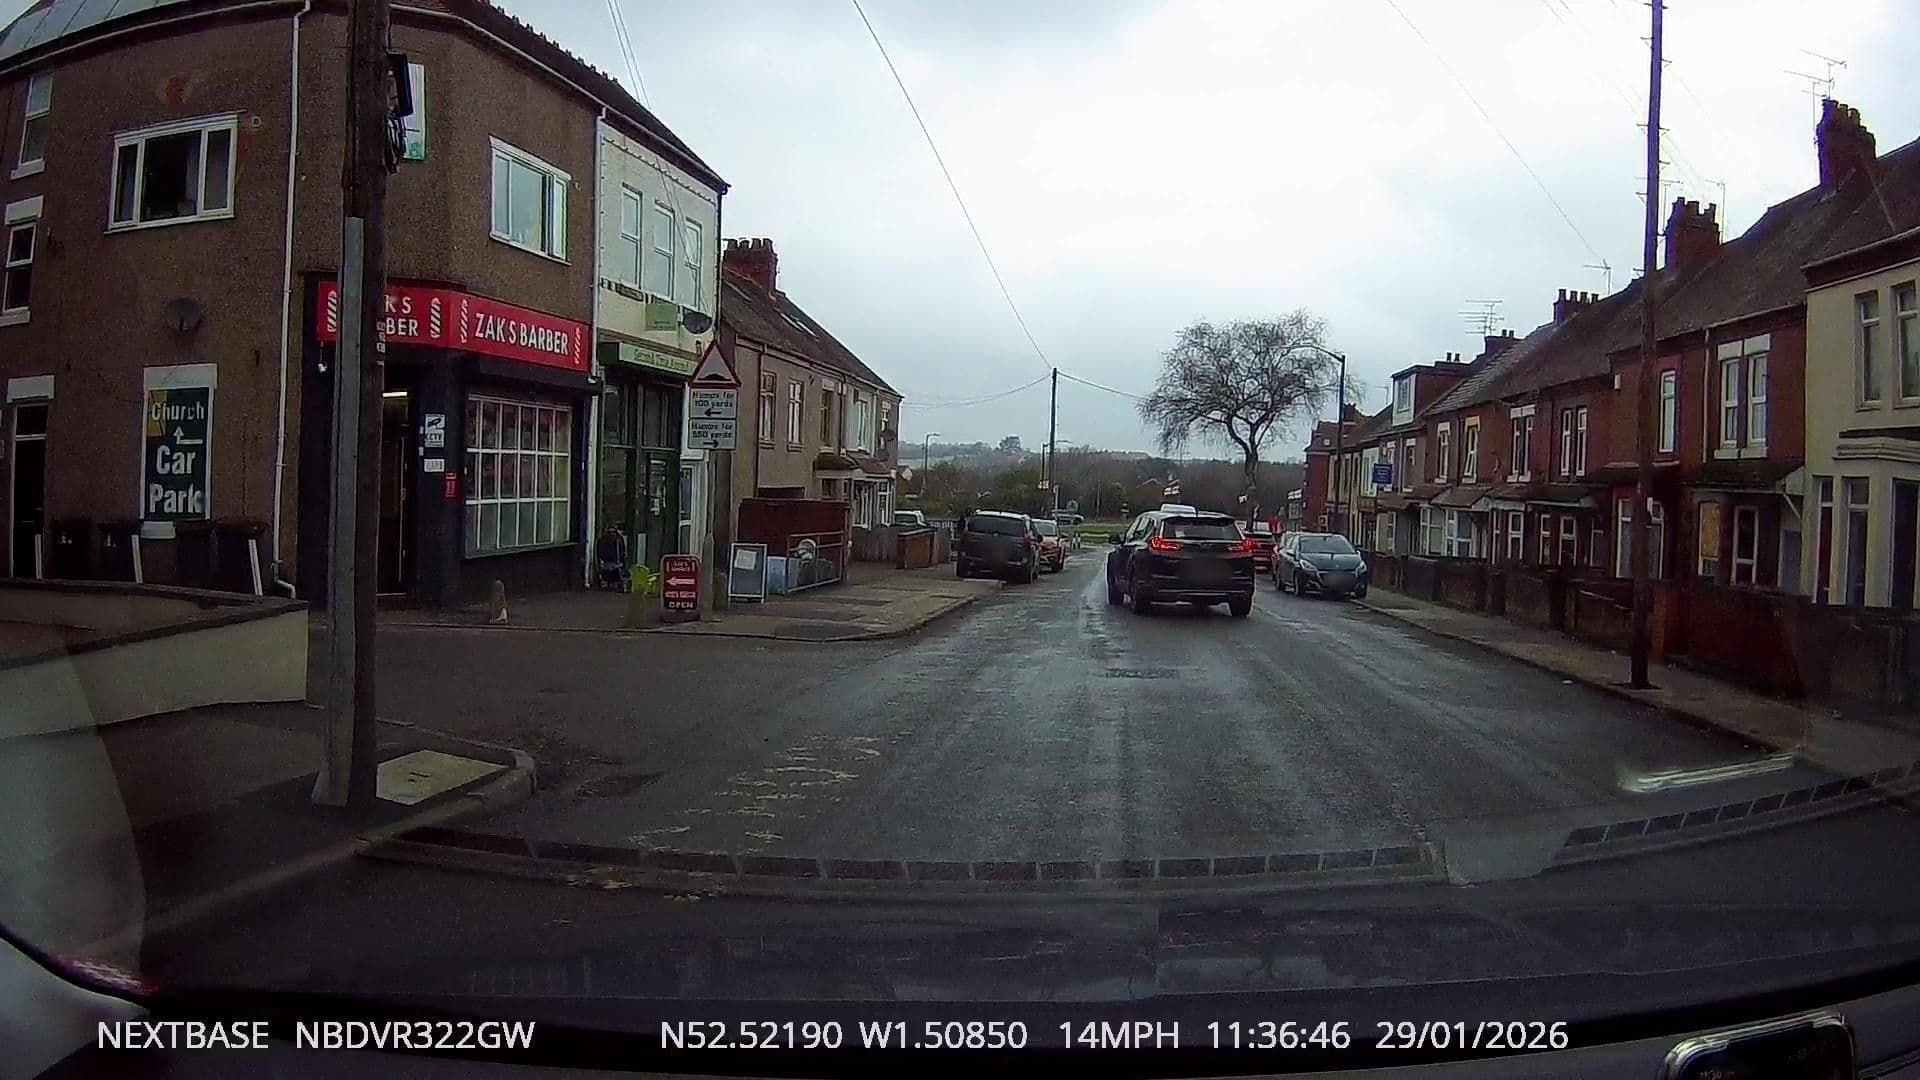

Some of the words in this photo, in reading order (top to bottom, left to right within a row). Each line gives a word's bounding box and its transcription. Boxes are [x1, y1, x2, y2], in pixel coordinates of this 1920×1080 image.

[385, 316, 419, 337] BER
[519, 322, 569, 355] BARBER
[151, 401, 205, 420] Church
[156, 444, 196, 474] Car
[148, 482, 202, 513] Park
[668, 601, 694, 609] OPEN
